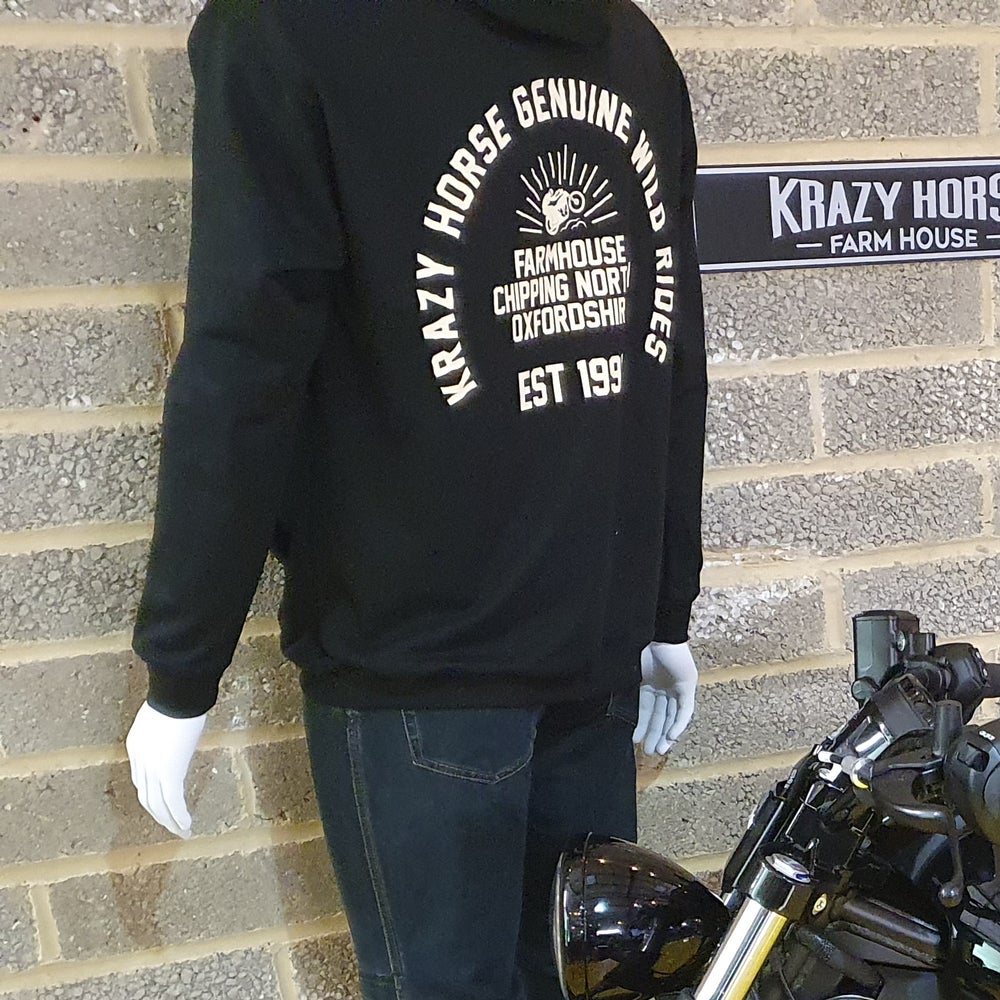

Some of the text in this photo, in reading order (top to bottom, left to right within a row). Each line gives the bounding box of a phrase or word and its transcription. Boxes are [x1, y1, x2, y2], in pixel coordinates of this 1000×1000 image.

[768, 175, 902, 239] KRAZY
[415, 77, 675, 406] KRAZY HORSE GENUINE WILD RIDES
[513, 234, 627, 280] FARMHOUSE
[830, 226, 979, 254] FARM HOUSE
[492, 262, 631, 317] CHIPPING NORT
[517, 354, 623, 412] EST 199
